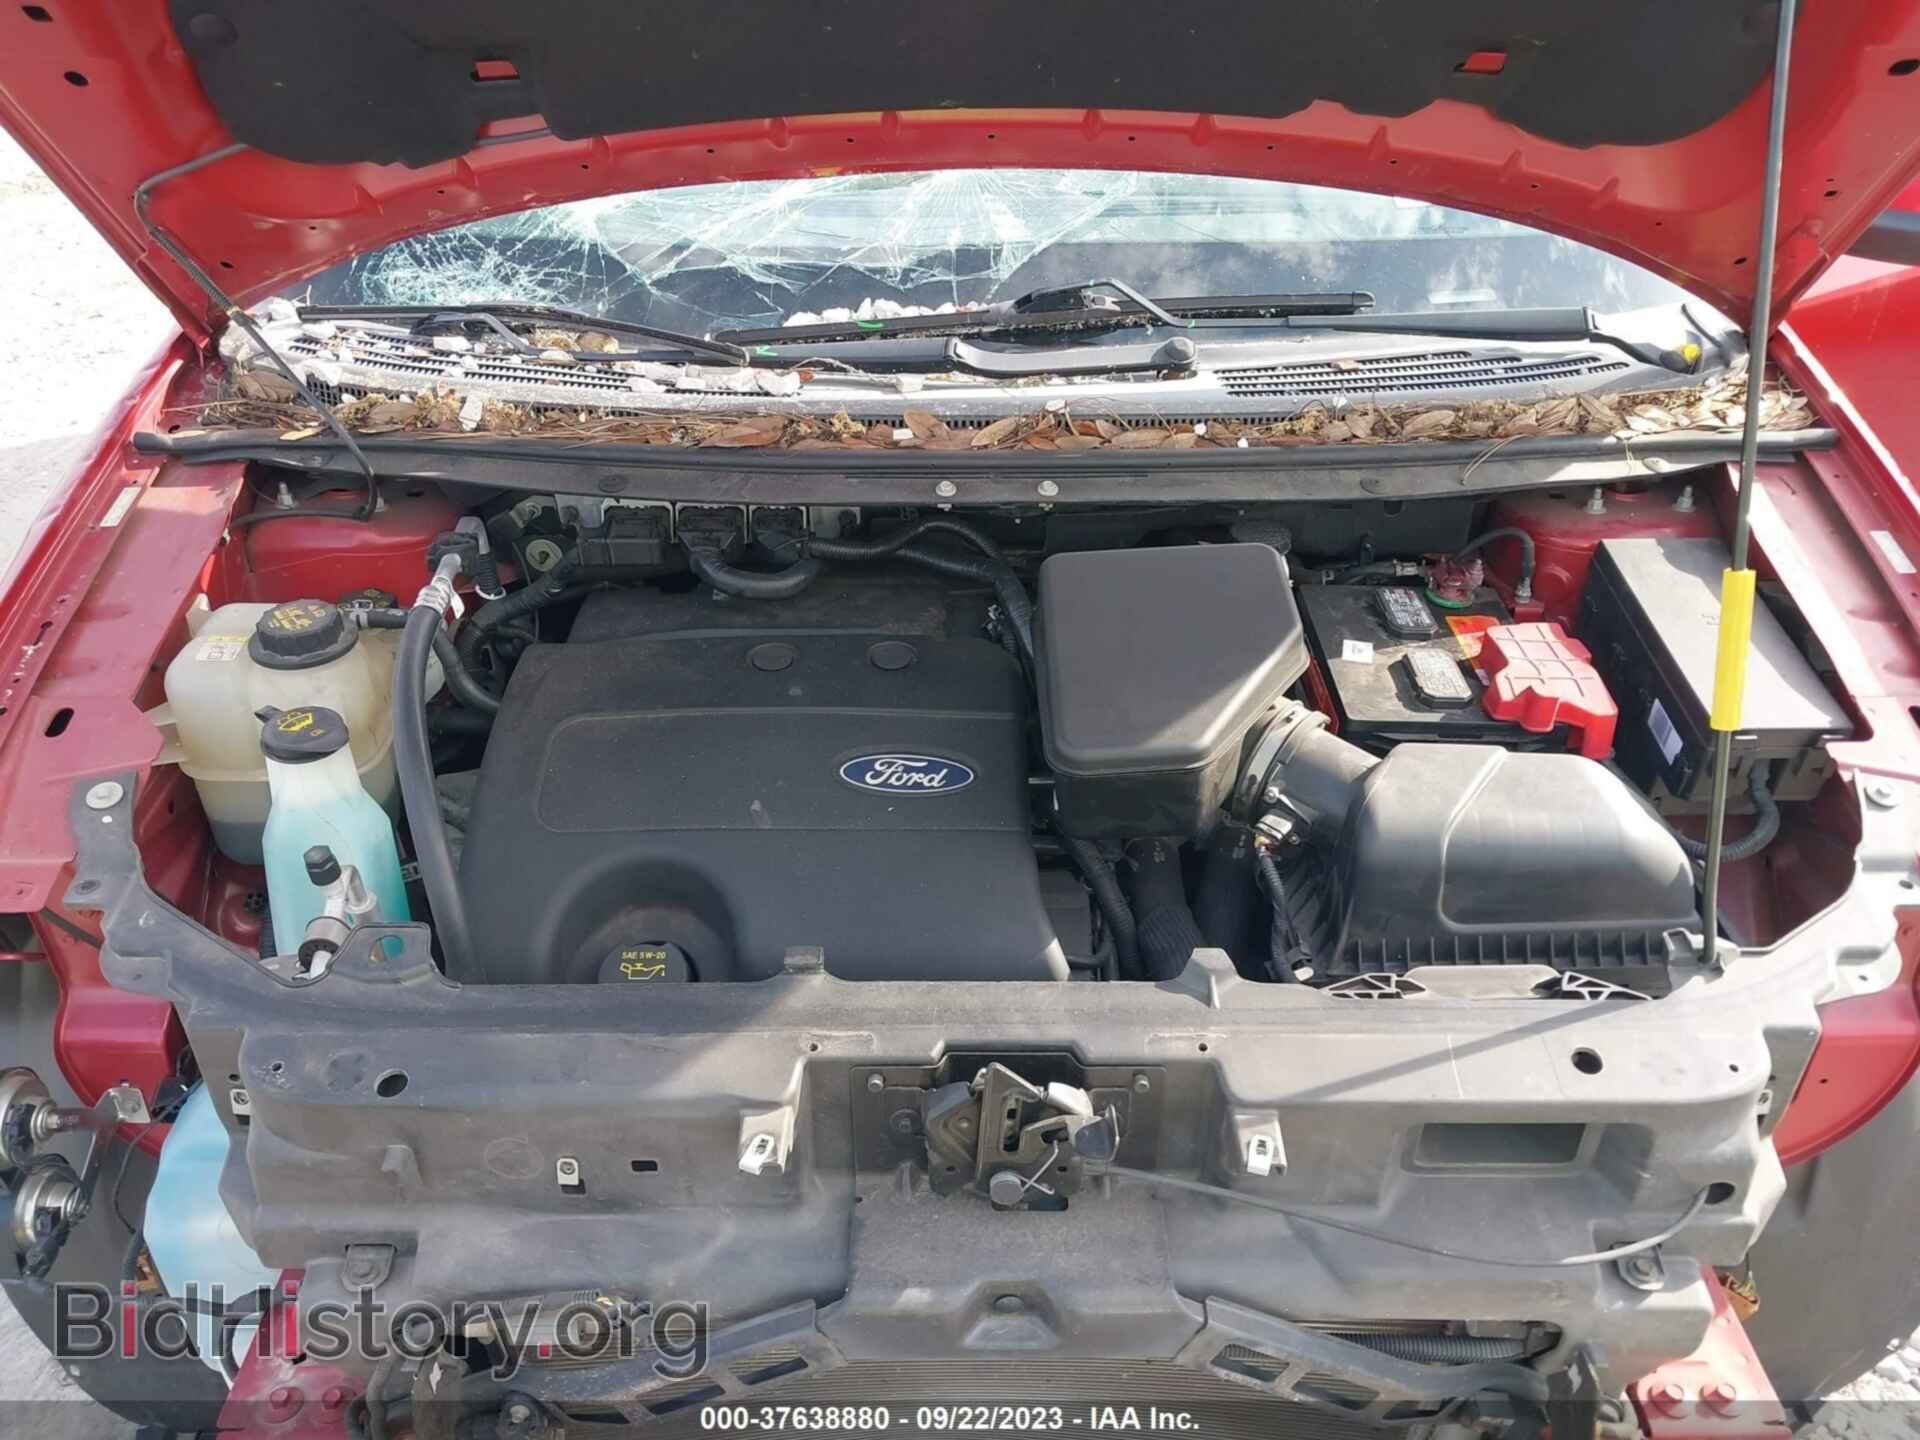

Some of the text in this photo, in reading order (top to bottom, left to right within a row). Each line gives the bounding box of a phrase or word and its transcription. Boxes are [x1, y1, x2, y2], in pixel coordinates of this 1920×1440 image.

[865, 758, 948, 787] Ford
[622, 951, 666, 960] SAE 5W-20
